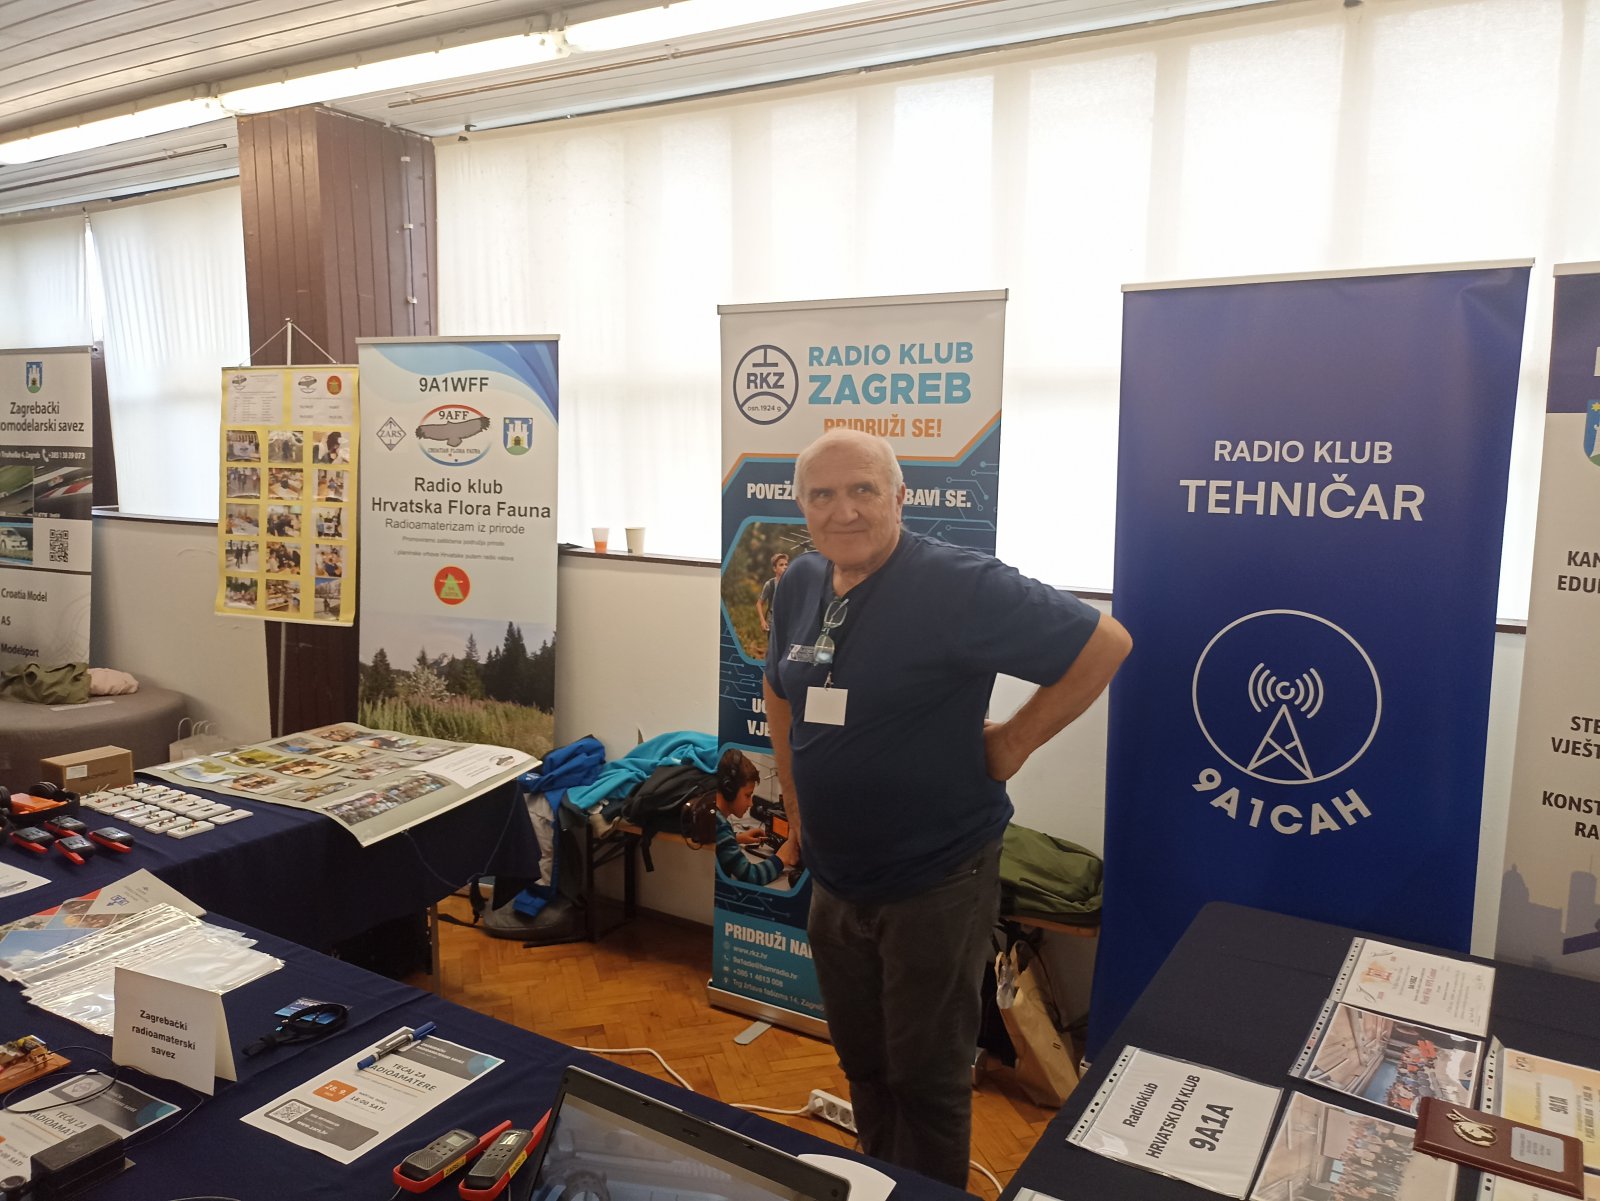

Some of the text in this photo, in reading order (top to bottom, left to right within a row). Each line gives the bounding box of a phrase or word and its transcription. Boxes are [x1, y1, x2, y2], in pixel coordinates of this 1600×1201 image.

[808, 342, 974, 367] RADIO KLUB
[419, 377, 489, 393] 9A1WFF
[746, 372, 785, 389] RKZ
[808, 372, 972, 405] ZAGREB
[0, 418, 85, 432] omodelarski savez
[438, 410, 470, 420] 9AFF
[911, 418, 942, 438] SE!
[1213, 440, 1393, 464] RADIO KLUB
[414, 476, 503, 495] Radio klub
[372, 497, 551, 519] Hrvatska Flora Fauna
[945, 489, 972, 508] SE.
[1179, 473, 1426, 522] TEHNIČAR
[385, 518, 526, 535] Radioamaterizam iz prirode
[1, 587, 48, 602] Croatia Model
[1557, 574, 1600, 594] EDU
[1, 616, 11, 626] AS
[1, 643, 39, 658] Modelsport
[1191, 767, 1373, 836] 9A1CAH
[725, 921, 787, 952] PRIDRUŽI
[140, 1009, 188, 1031] Zagrebački
[131, 1025, 196, 1051] radioamaterski
[151, 1046, 176, 1060] savez
[370, 1064, 438, 1091] ADIOAMATERE
[1122, 1082, 1159, 1128] Radioklub
[1145, 1074, 1201, 1159] HRVATSKI DX KLUB
[1188, 1103, 1234, 1152] 9A1A
